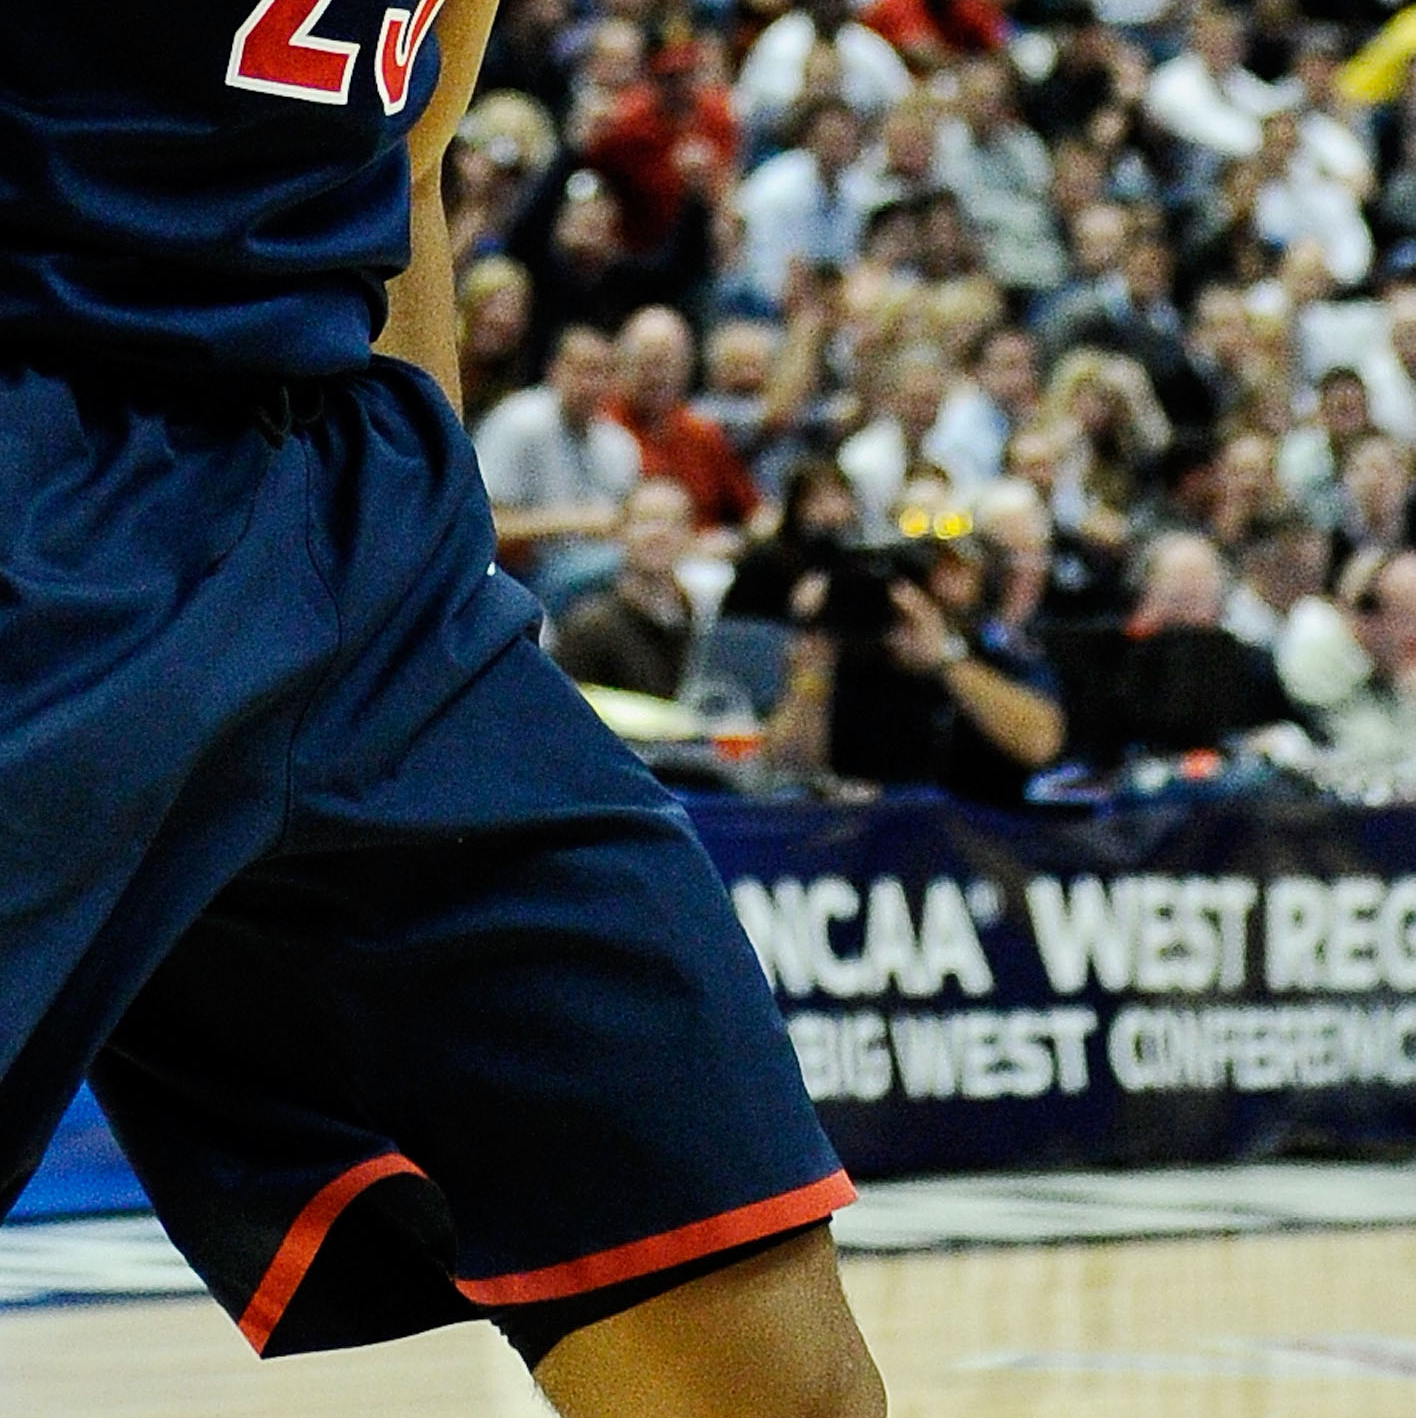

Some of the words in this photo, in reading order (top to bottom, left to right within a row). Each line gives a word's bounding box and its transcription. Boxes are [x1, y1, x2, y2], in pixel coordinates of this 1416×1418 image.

[733, 876, 994, 998] NCAA
[1025, 875, 1260, 995] WEST
[787, 1011, 892, 1101] BIG
[888, 1007, 1098, 1100] WEST
